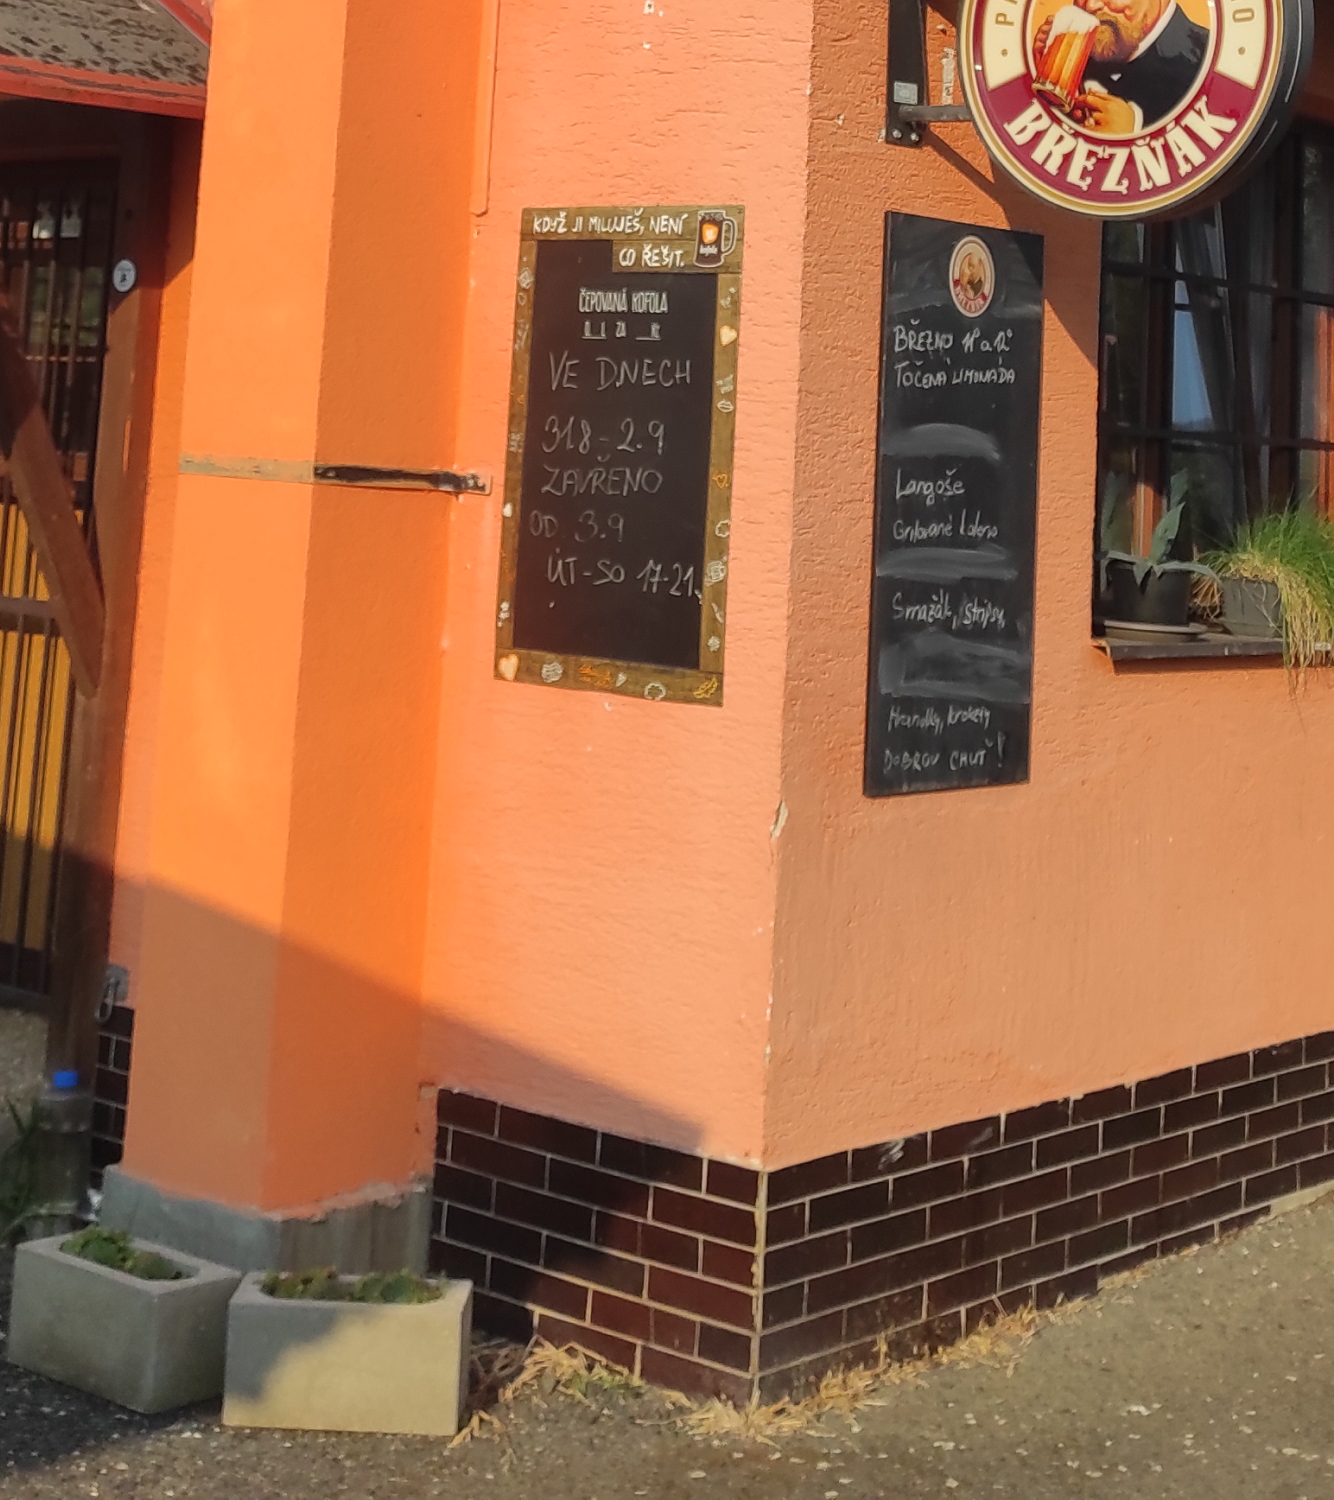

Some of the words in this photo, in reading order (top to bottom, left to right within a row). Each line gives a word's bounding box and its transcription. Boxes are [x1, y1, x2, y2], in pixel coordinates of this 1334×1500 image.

[1003, 95, 1237, 195] BŘEZŇÁK
[533, 211, 567, 235] KDYŽ
[571, 216, 583, 233] JI
[588, 208, 644, 235] MILUJEŠ,
[649, 213, 688, 235] NENÍ
[619, 248, 636, 266] CO
[642, 244, 685, 268] ŘEŠIT.
[579, 287, 628, 313] ČEPOVANÁ
[632, 291, 668, 313] KOFOLA
[893, 318, 954, 353] BŘEZNO
[549, 351, 580, 391] VE
[596, 356, 691, 391] DNECH
[541, 454, 663, 496] ZAVŘENO
[896, 468, 965, 506] Langoše
[530, 510, 558, 538] OD
